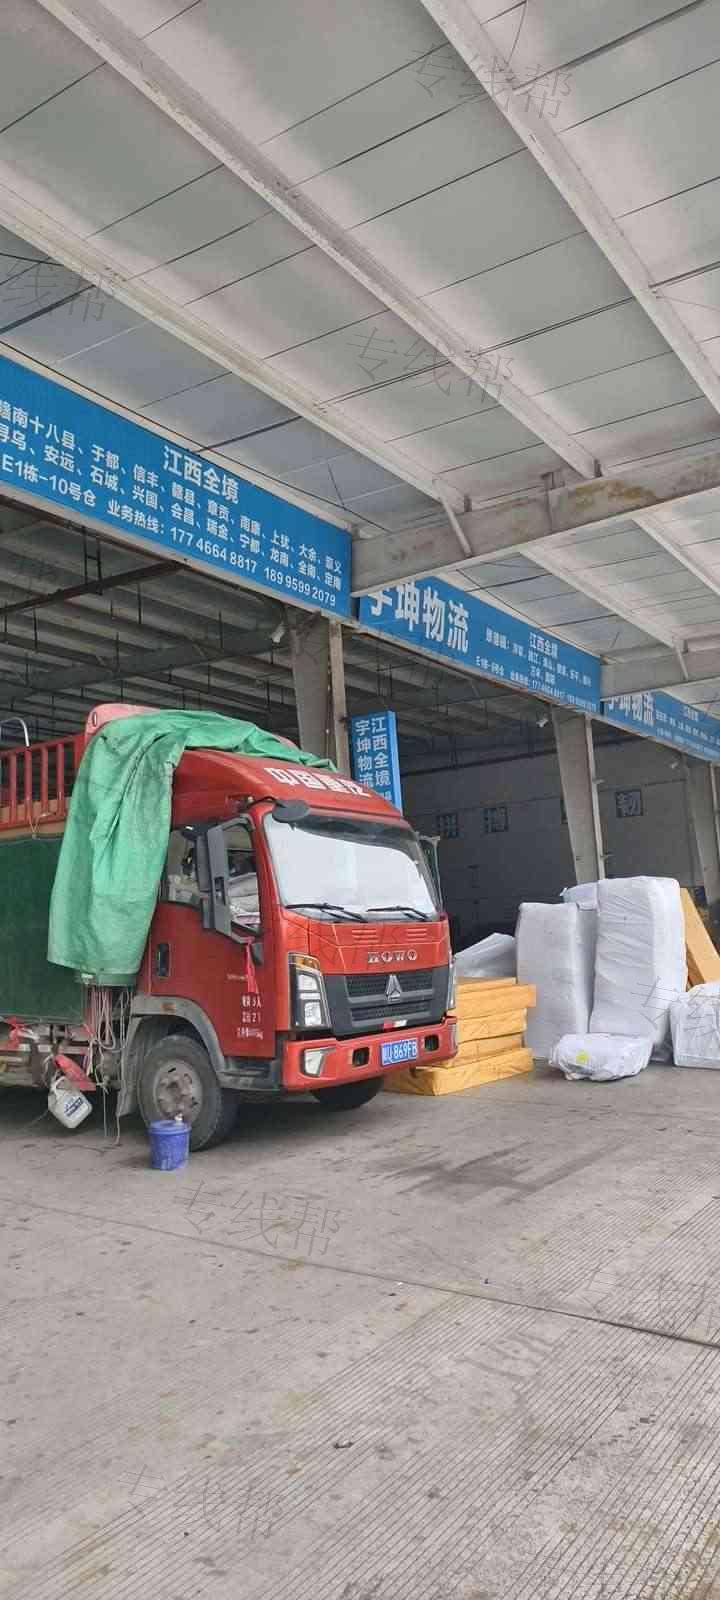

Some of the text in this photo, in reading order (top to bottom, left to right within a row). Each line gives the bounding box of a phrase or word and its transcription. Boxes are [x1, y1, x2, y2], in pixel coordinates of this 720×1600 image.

[163, 445, 239, 504] 江西全境
[2, 455, 96, 507] E1栋-10号仓
[108, 499, 164, 535] 业务热线：
[170, 527, 193, 546] 177
[196, 540, 226, 560] 4664
[230, 551, 257, 573] 8817
[264, 567, 283, 584] 189
[312, 586, 336, 606] 2079
[263, 767, 371, 797] 中国重汽
[371, 716, 391, 786] 江西全境
